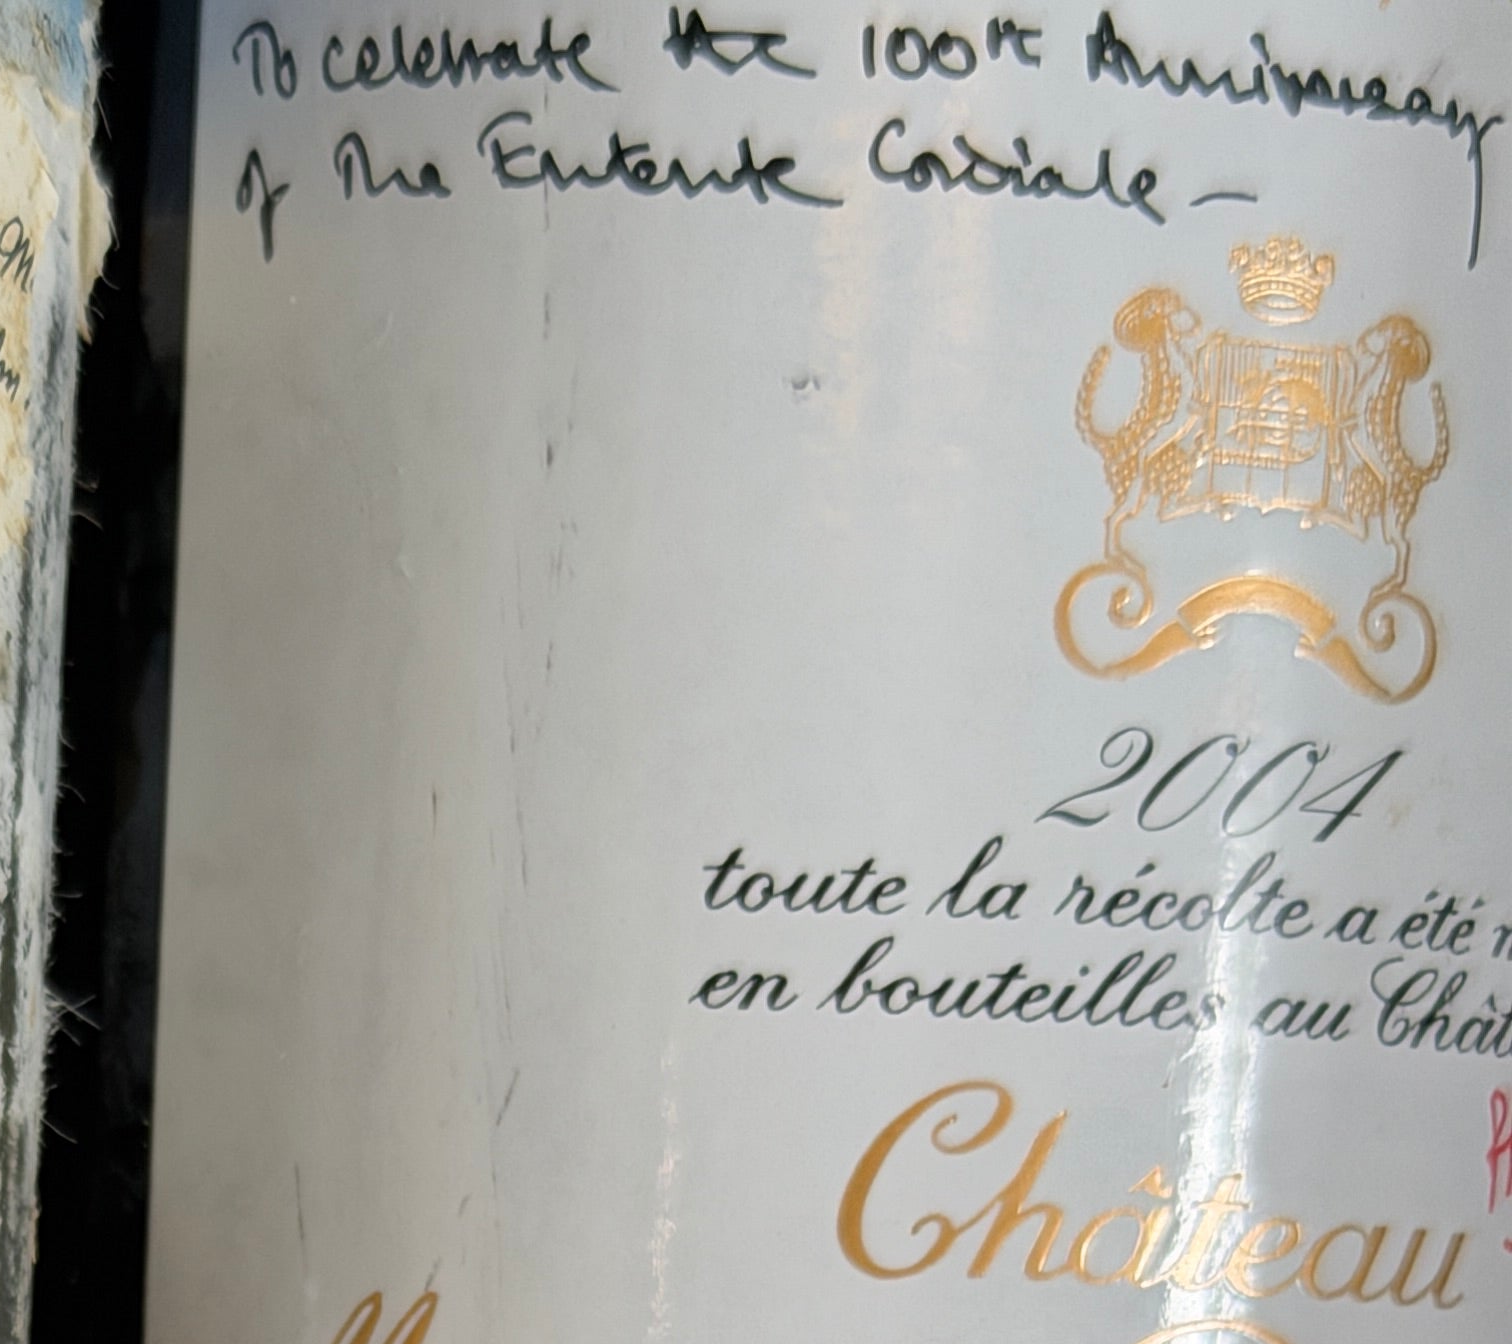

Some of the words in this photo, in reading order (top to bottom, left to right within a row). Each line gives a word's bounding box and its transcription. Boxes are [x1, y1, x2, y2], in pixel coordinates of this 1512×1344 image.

[322, 16, 622, 93] celebrate
[477, 110, 845, 209] Entente
[869, 118, 1167, 226] Cordiale
[1034, 726, 1407, 844] 2004
[701, 845, 908, 920] toute
[923, 834, 1030, 921] la
[1052, 850, 1315, 942] récolte
[1324, 905, 1380, 945] a
[1389, 889, 1486, 956] été
[689, 964, 801, 1013] en
[816, 936, 1223, 1033] bouteilles
[1252, 998, 1352, 1042] au
[836, 1080, 1466, 1310] Château
